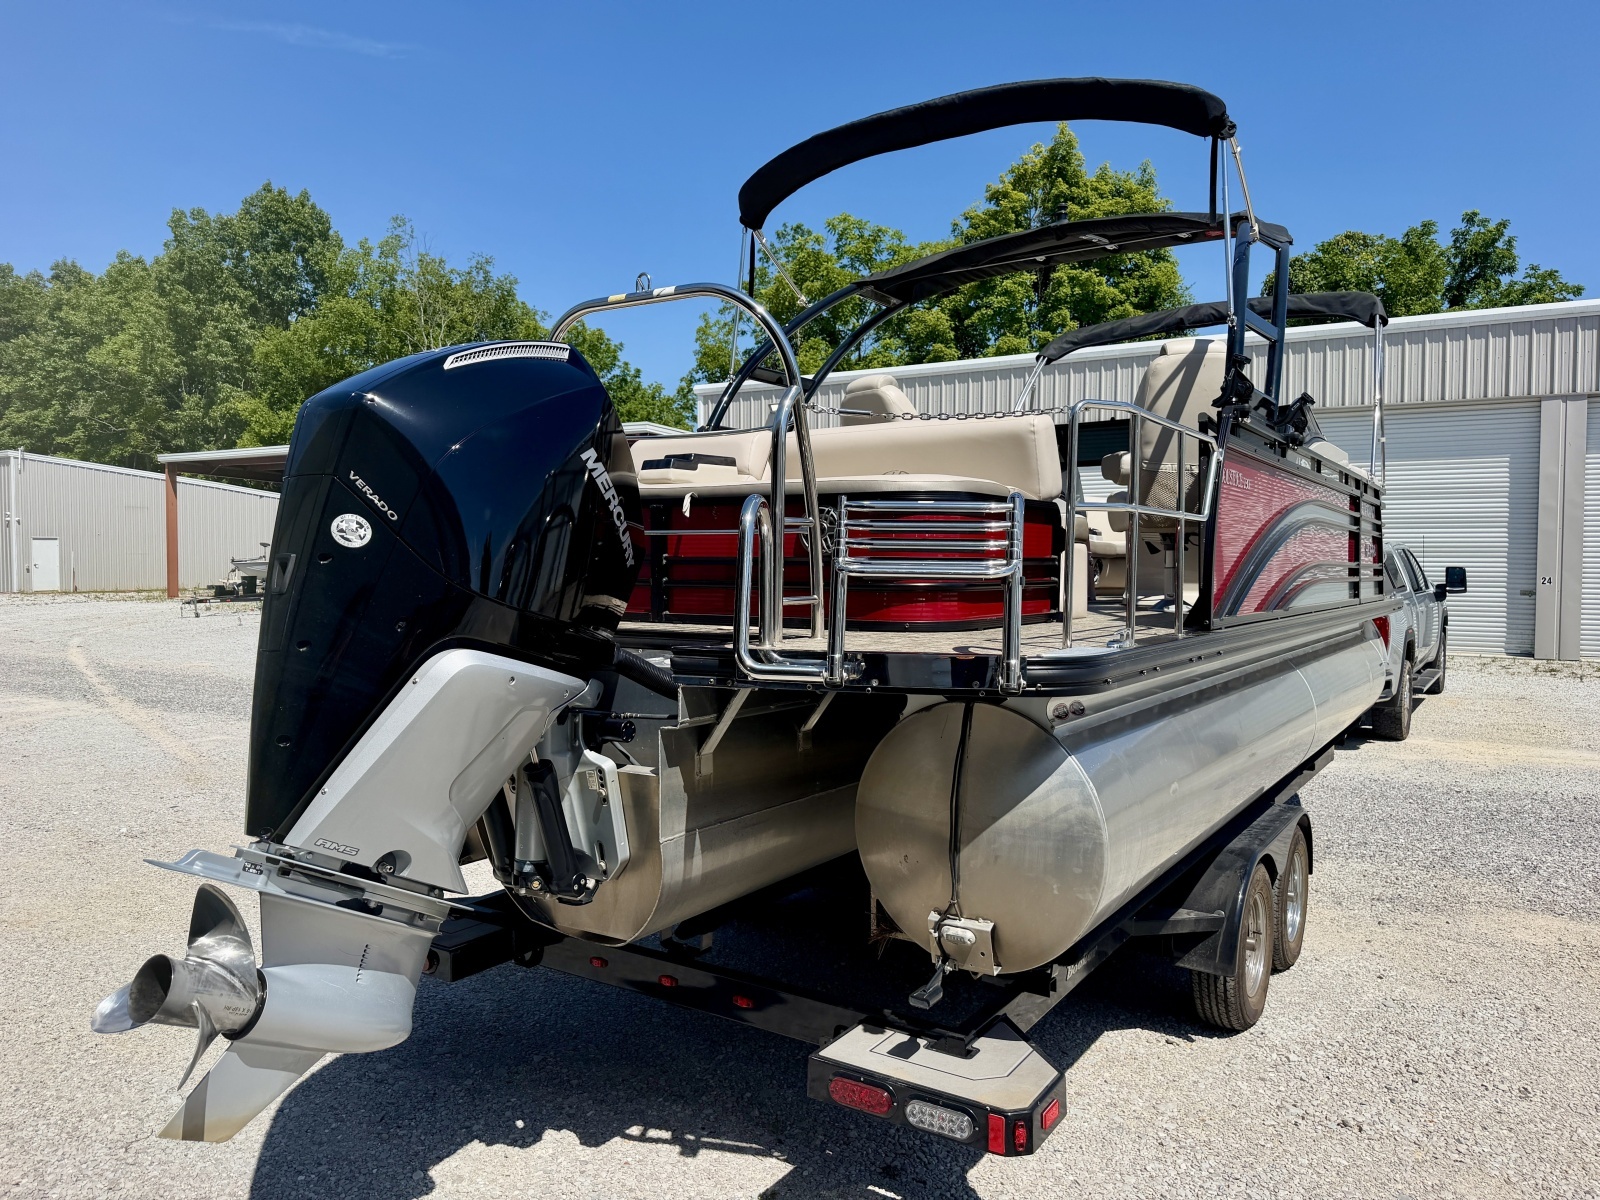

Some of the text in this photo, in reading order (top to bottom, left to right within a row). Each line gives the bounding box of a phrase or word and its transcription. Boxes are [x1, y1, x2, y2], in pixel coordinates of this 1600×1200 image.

[349, 470, 398, 520] VERADO
[580, 447, 634, 568] MERCURY
[1541, 576, 1552, 585] 24
[314, 838, 360, 856] AMS
